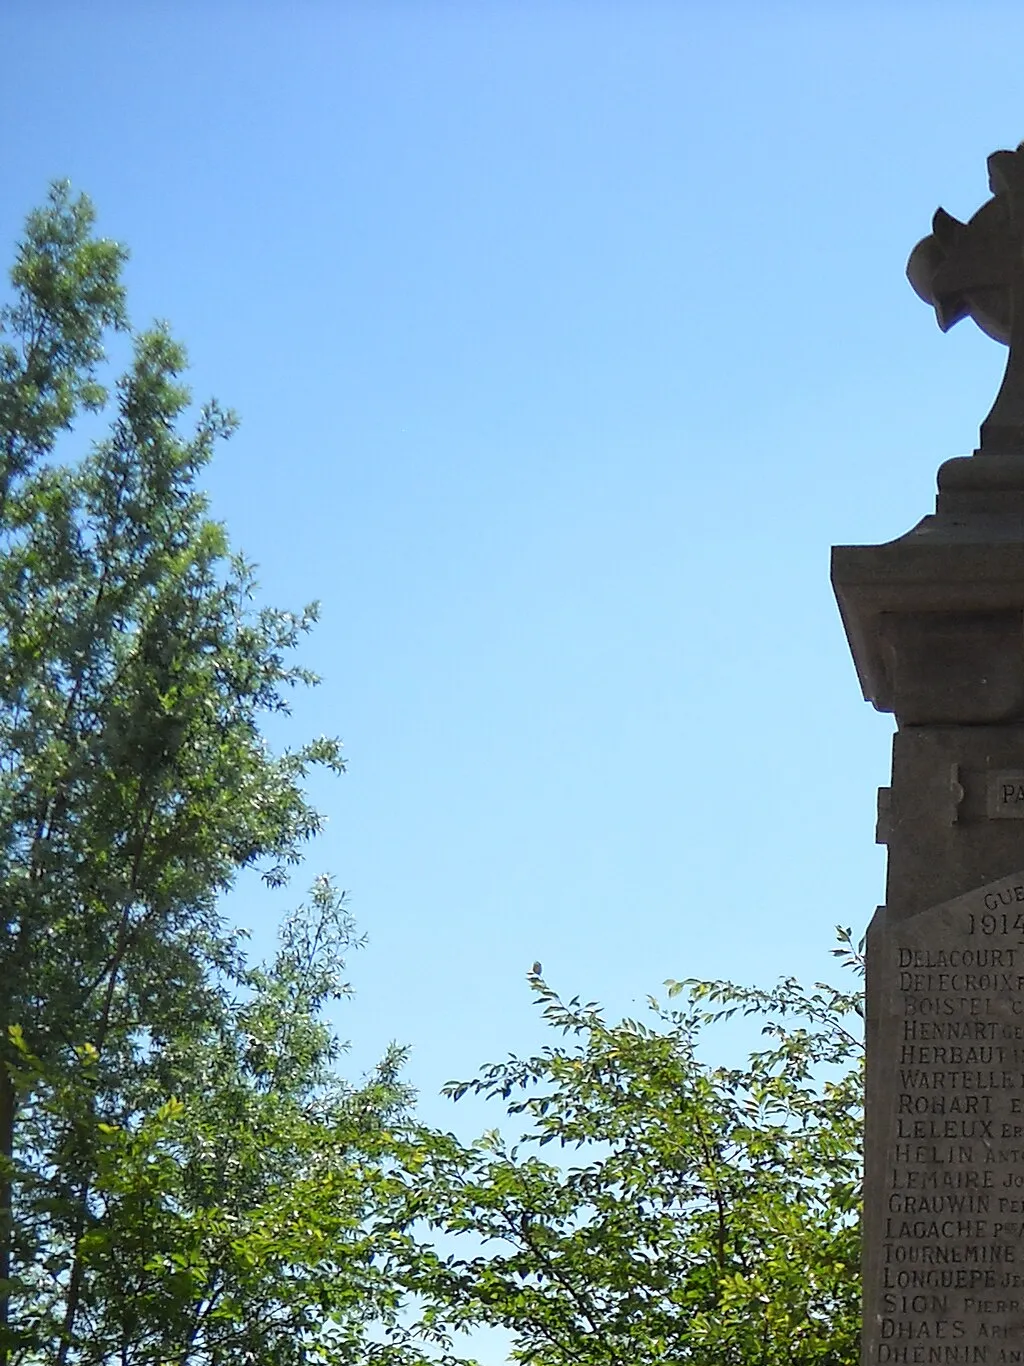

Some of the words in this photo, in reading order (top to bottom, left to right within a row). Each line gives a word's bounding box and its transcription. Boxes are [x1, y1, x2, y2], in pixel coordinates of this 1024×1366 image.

[898, 947, 1017, 968] DELACOURT
[899, 971, 1013, 992] DELECROIX
[904, 996, 997, 1015] BOISTEL
[903, 1020, 998, 1040] HENNART
[900, 1045, 1005, 1064] HERBAUT
[899, 1069, 1014, 1089] WARTELLE
[898, 1094, 993, 1115] ROHART
[897, 1118, 995, 1138] LELEUX
[891, 1168, 995, 1189] LEMAIRE
[888, 1193, 990, 1214] GRAUWIN
[885, 1217, 988, 1239] LAGACHE
[883, 1243, 1015, 1264] TOURNEMINE
[883, 1292, 947, 1313] SION
[881, 1318, 966, 1339] DHAES
